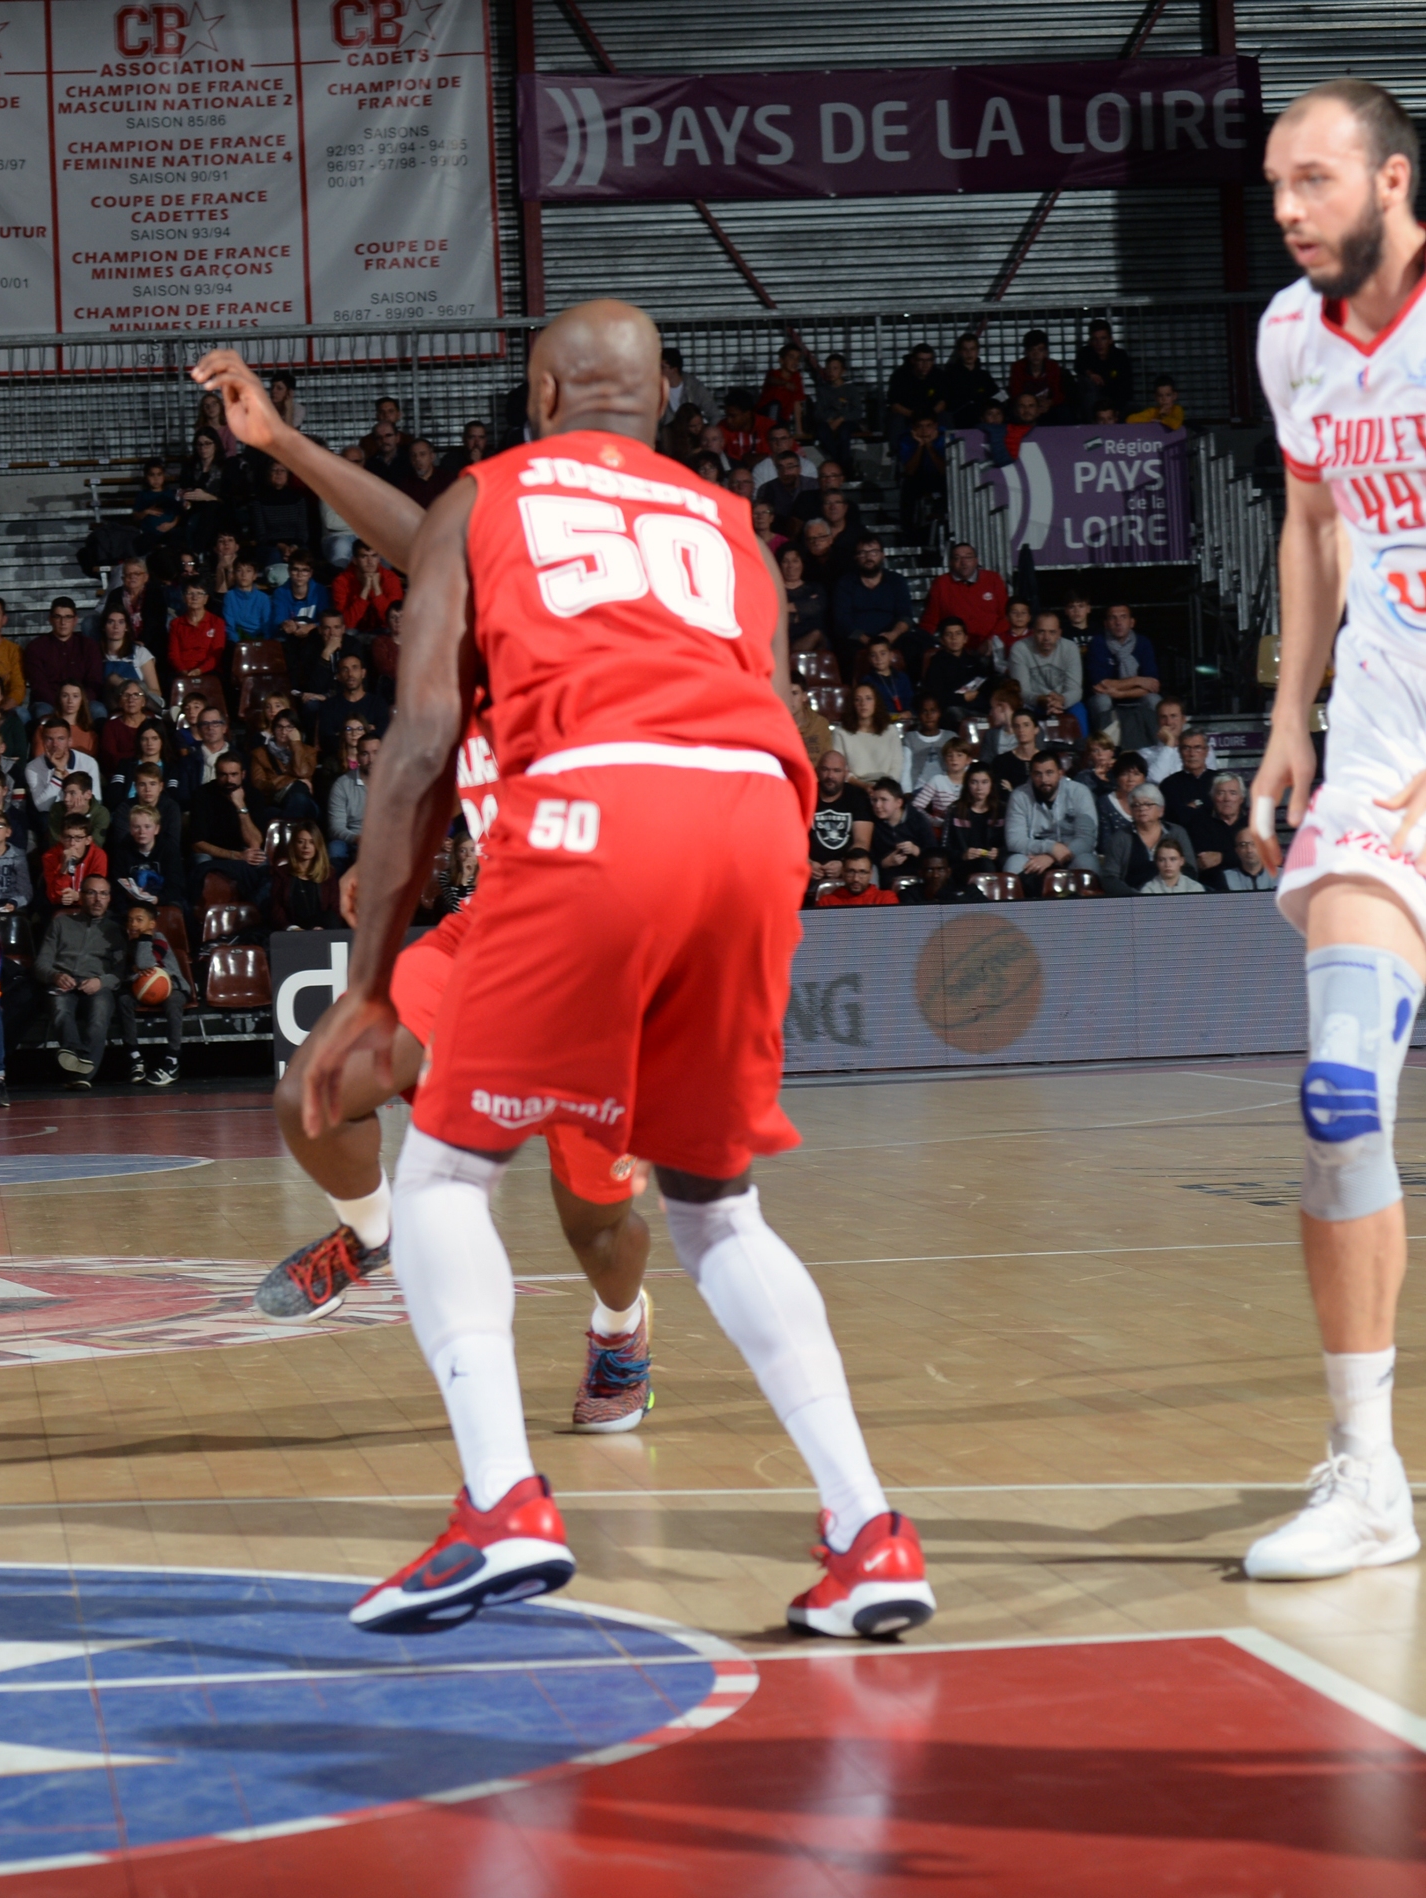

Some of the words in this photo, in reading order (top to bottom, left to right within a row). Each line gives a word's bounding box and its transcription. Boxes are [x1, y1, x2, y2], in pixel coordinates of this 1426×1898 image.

[114, 3, 189, 59] CB
[347, 49, 429, 66] CADETS
[100, 59, 245, 77] ASSOCIATION
[66, 83, 171, 98] CHAMPION
[178, 82, 201, 94] DE
[207, 78, 283, 93] FRANCE
[328, 77, 431, 95] CHAMPION
[437, 76, 461, 89] DE
[58, 100, 156, 114] MASCULIN
[163, 95, 277, 111] NATIONALE
[283, 94, 293, 106] 2
[358, 95, 432, 110] FRANCE
[126, 116, 183, 129] SAISON
[187, 115, 227, 127] 85/86
[620, 103, 795, 167] PAYS
[819, 101, 910, 164] DE
[935, 97, 1024, 160] LA
[1047, 88, 1248, 154] LOIRE
[364, 126, 429, 139] SAISONS
[68, 140, 173, 154] CHAMPION
[180, 138, 203, 151] DE
[210, 135, 286, 149] FRANCE
[327, 145, 365, 157] 92/93
[378, 142, 415, 155] 93/94
[62, 156, 156, 171] FEMININE
[162, 152, 277, 168] NATIONALE
[282, 151, 293, 163] 4
[327, 160, 365, 172] 96/97
[379, 157, 416, 170] 97/98
[129, 172, 186, 185] SAISON
[191, 170, 228, 183] 90/91
[328, 177, 365, 188] 00/01
[91, 195, 155, 208] COUPE
[161, 194, 185, 207] DE
[191, 190, 268, 205] FRANCE
[131, 209, 229, 223] CADETTES
[130, 228, 188, 241] SAISON
[192, 227, 230, 239] 93/94
[72, 250, 178, 264] CHAMPION
[184, 249, 208, 261] DE
[215, 245, 291, 260] FRANCE
[355, 240, 418, 255] COUPE
[425, 239, 448, 251] DE
[91, 266, 174, 280] MINIMES
[180, 262, 273, 278] GARÇONS
[365, 256, 440, 270] FRANCE
[132, 285, 190, 297] SAISON
[195, 283, 233, 296] 93/94
[371, 291, 437, 304] SAISONS
[74, 305, 179, 320] CHAMPION
[186, 304, 209, 316] DE
[216, 301, 293, 315] FRANCE
[334, 309, 371, 322] 86/87
[385, 307, 423, 319] 89/90
[437, 304, 475, 317] 96/97
[110, 320, 191, 332] MINIMES
[1105, 438, 1163, 457] Région
[1075, 459, 1164, 493] PAYS
[1127, 496, 1147, 510] de
[1152, 495, 1165, 509] la
[1063, 513, 1168, 549] LOIRE
[517, 494, 743, 639] 50
[527, 798, 601, 853] 50
